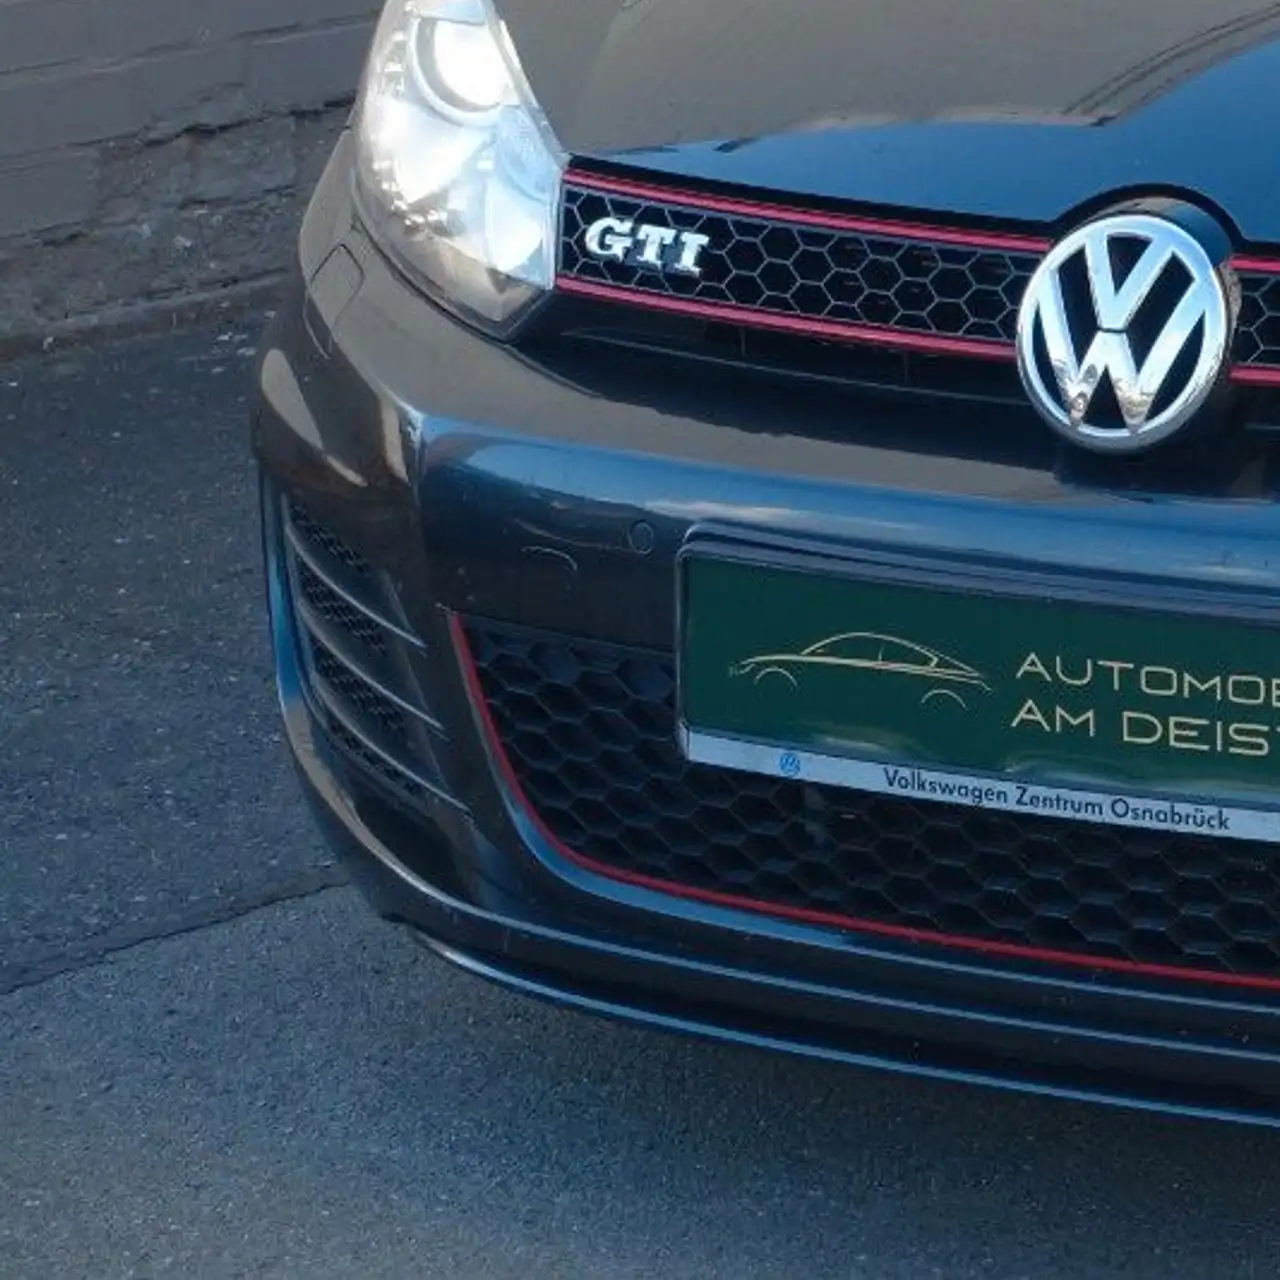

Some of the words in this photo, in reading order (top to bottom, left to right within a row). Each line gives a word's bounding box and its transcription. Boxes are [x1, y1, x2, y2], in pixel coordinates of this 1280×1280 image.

[585, 216, 710, 278] GTI
[1018, 214, 1228, 453] VW
[1011, 698, 1097, 738] AM
[883, 766, 1009, 807] Volkswagen
[1014, 785, 1103, 816] Zentrum
[1110, 797, 1231, 832] Osnabrück
